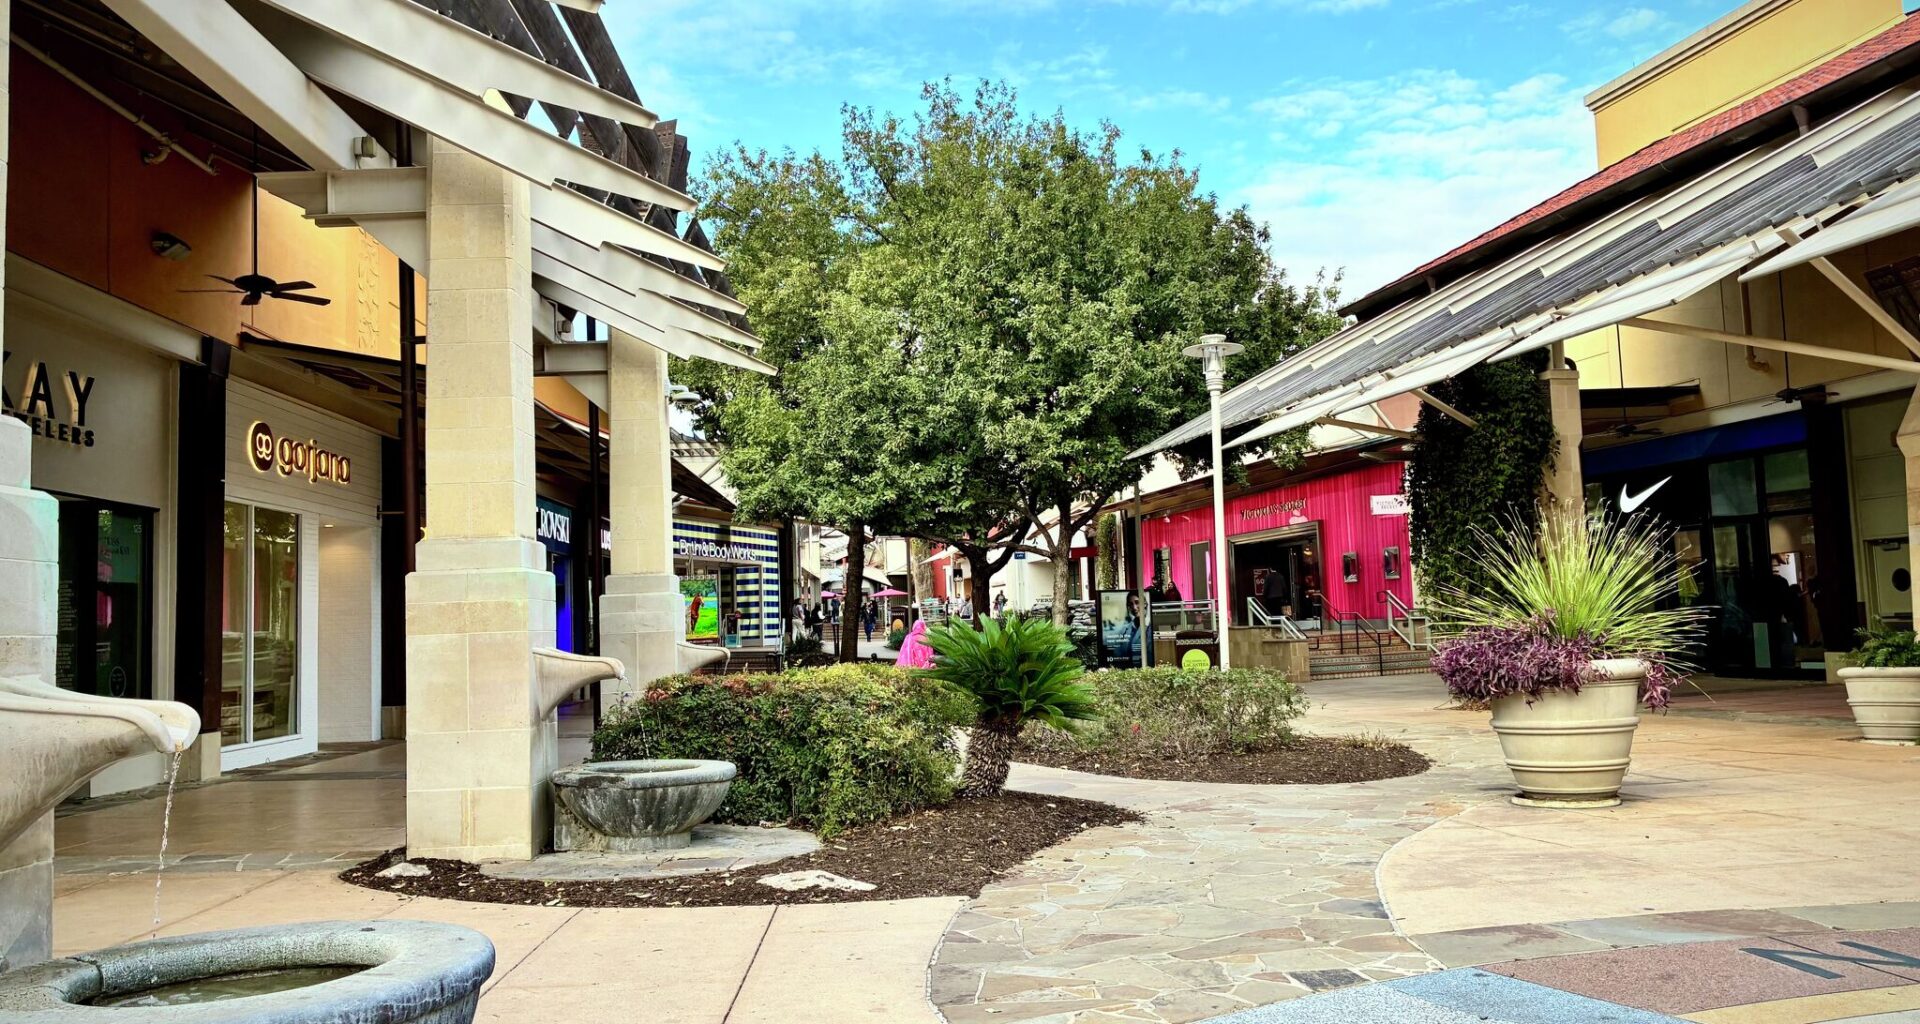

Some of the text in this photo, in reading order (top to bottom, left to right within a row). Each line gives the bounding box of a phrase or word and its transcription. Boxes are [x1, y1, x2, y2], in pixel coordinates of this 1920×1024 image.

[2, 408, 95, 447] ELERS
[277, 438, 350, 484] gorjana
[536, 507, 570, 544] ROVSKI
[709, 542, 731, 562] Body
[731, 544, 756, 561] Works
